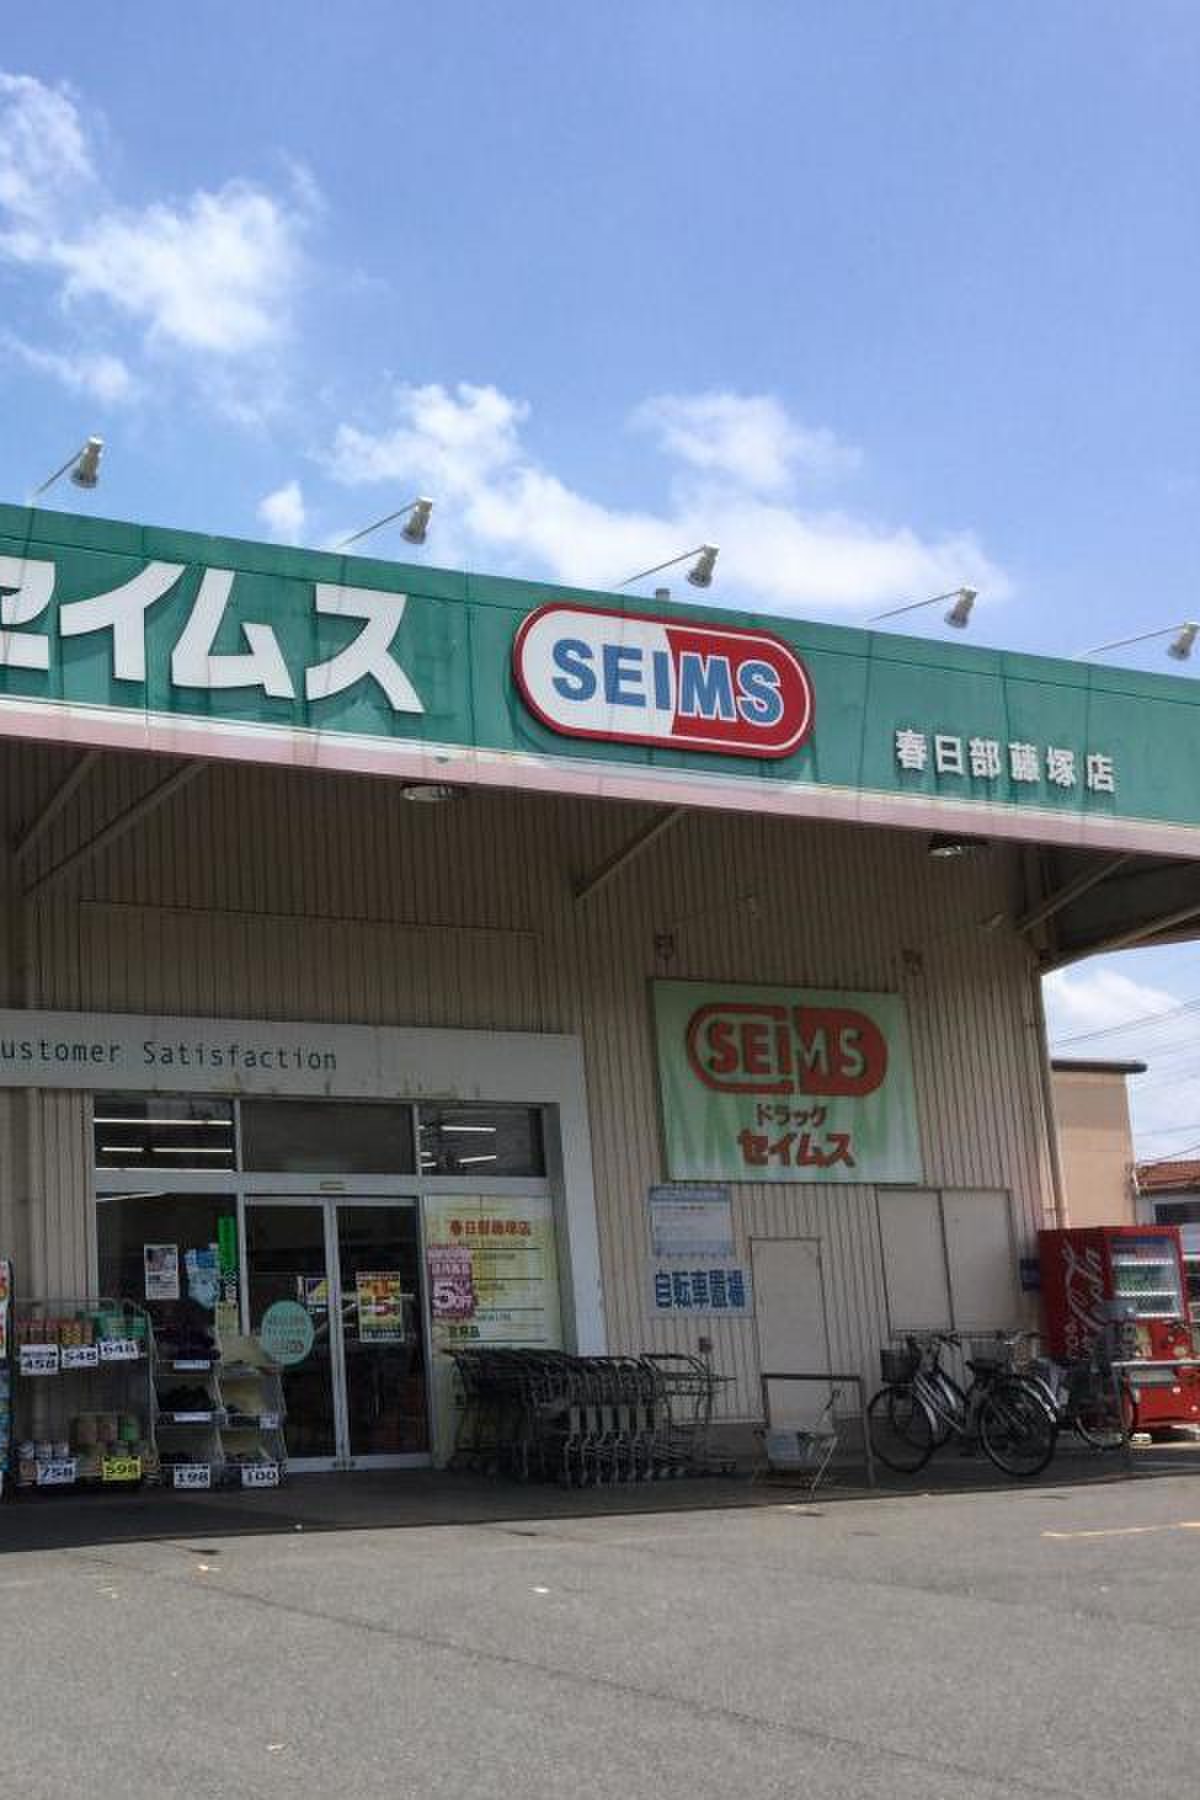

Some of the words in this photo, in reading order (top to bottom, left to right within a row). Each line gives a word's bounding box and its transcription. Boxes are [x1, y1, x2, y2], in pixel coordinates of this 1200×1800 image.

[551, 638, 785, 728] SEIMS
[896, 729, 1115, 793] 春日部藤塚店
[143, 1041, 338, 1070] Satisfaction
[706, 1020, 867, 1079] SEIMS
[736, 1128, 856, 1168] セイムス
[655, 1269, 745, 1308] 自転車置場
